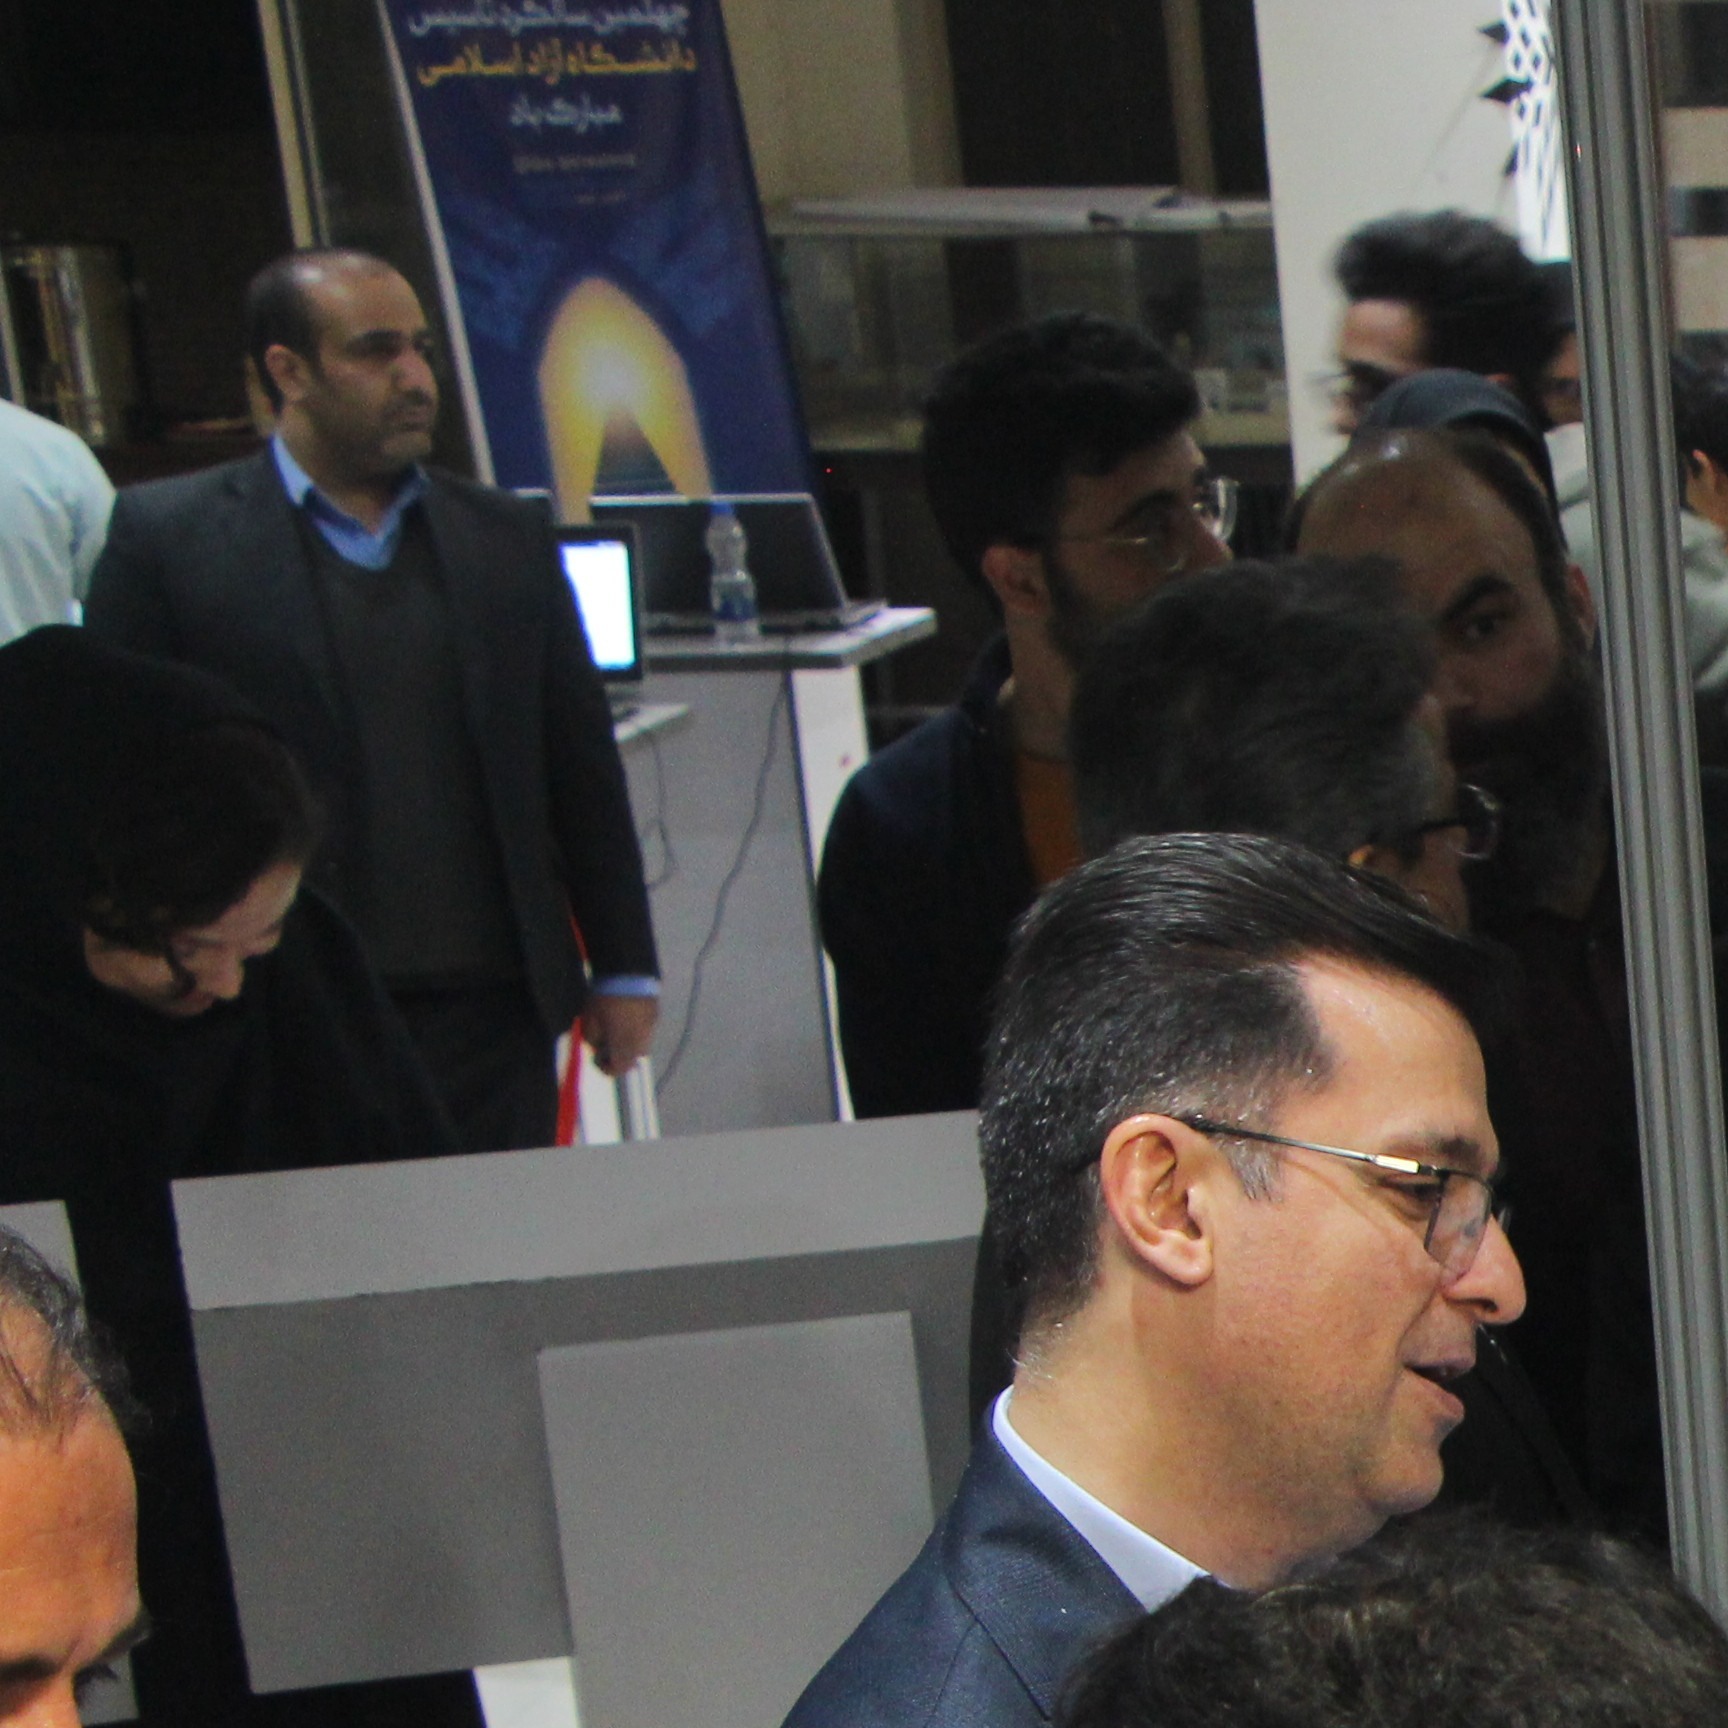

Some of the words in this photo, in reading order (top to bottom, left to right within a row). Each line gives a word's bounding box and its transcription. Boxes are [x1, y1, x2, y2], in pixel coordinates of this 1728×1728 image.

[416, 41, 522, 87] اسلامی
[527, 37, 563, 86] آزاد
[567, 38, 697, 74] دانشگاه
[509, 93, 543, 134] باد
[545, 93, 622, 134] مبارک
